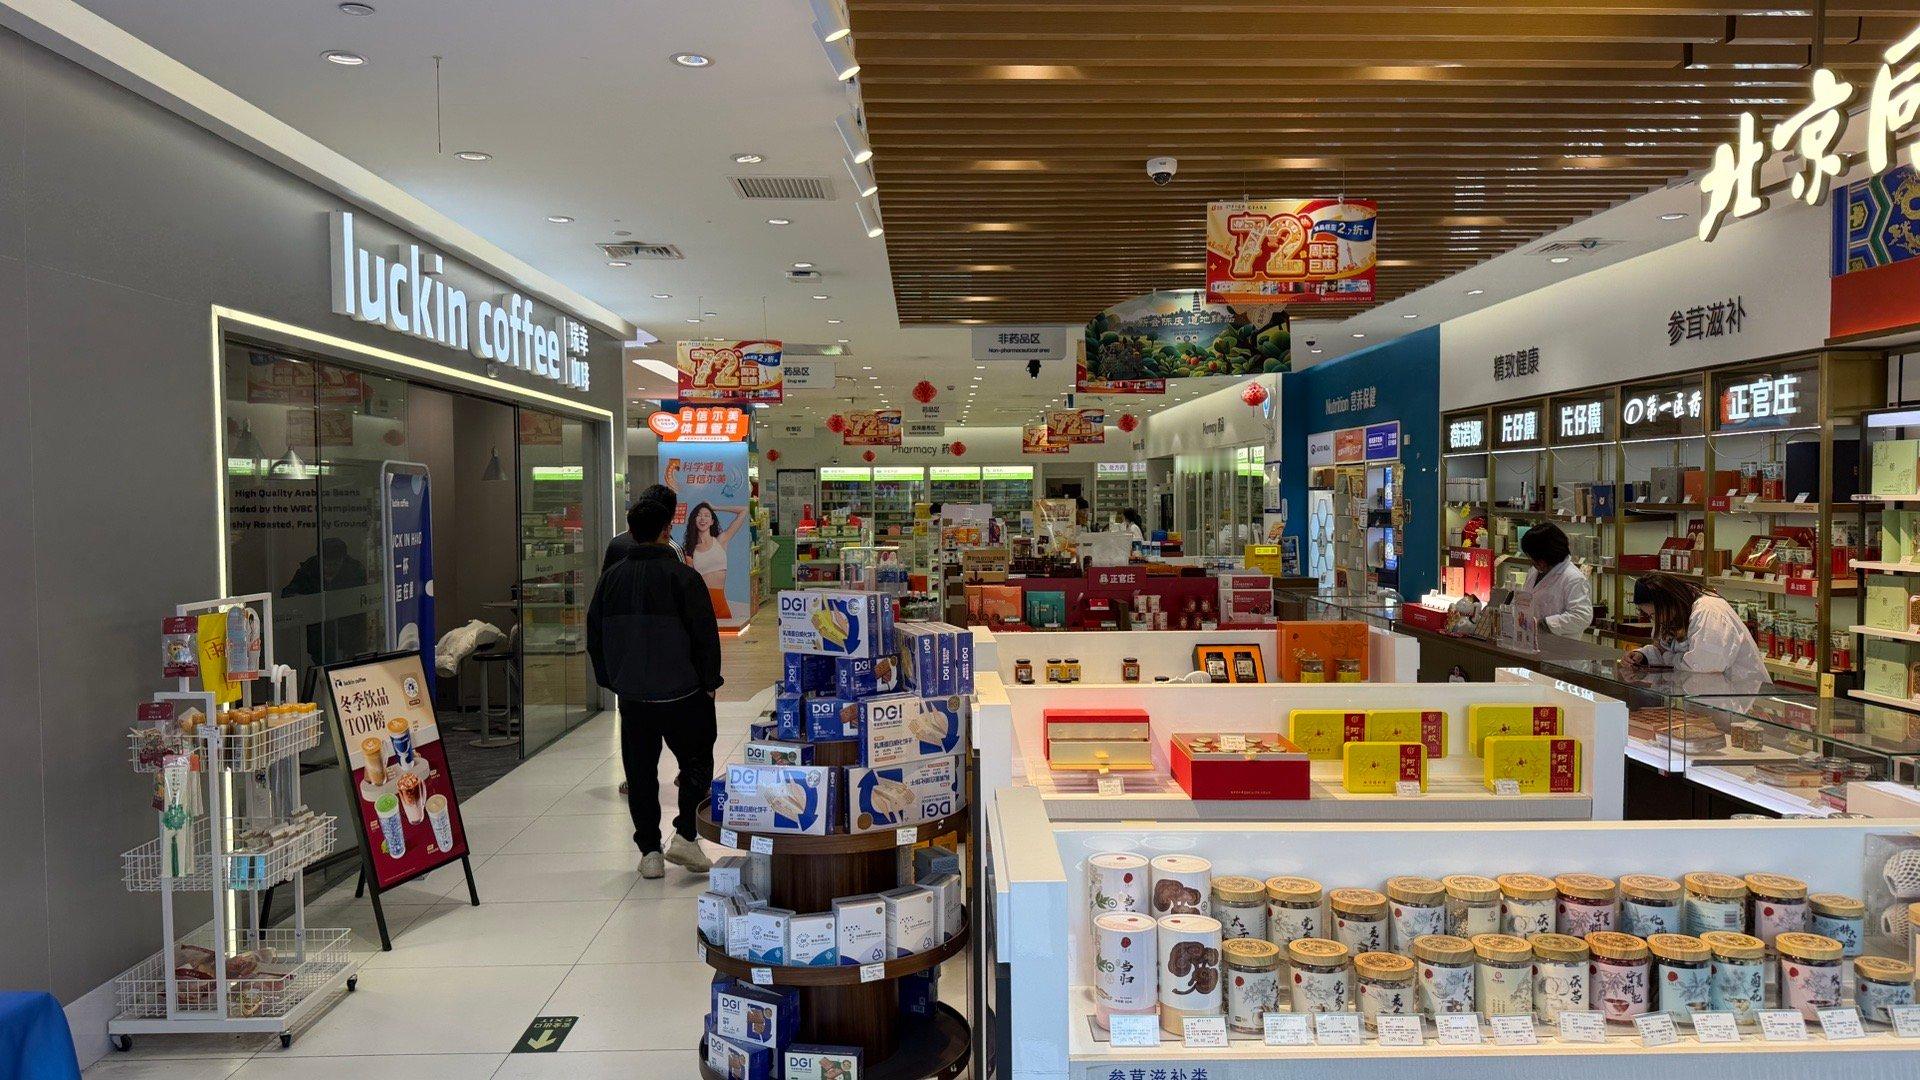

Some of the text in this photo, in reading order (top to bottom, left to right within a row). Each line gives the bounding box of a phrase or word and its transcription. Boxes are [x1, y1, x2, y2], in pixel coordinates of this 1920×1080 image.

[1230, 215, 1306, 275] 72
[335, 211, 561, 381] luckin coffee
[1668, 295, 1746, 347] 参茸滋补
[998, 333, 1040, 345] 非药品区
[690, 348, 740, 388] 72
[784, 366, 810, 377] 药品区
[1493, 346, 1539, 382] 精致健康
[1728, 375, 1797, 420] 正官庄
[682, 410, 741, 421] 自信尔美
[681, 422, 738, 434] 体重管理
[892, 444, 938, 457] Pharmacy
[235, 489, 257, 500] High
[272, 504, 287, 513] the
[1110, 574, 1136, 584] 正官庄
[782, 597, 807, 612] DGI
[854, 659, 871, 671] DGI
[340, 687, 390, 714] 冬季饮品
[812, 703, 835, 713] DGI
[783, 711, 791, 728] DGI
[873, 703, 903, 722] DGI
[346, 710, 386, 737] TOP榜
[747, 747, 765, 758] DGI
[1406, 758, 1417, 776] 阿胶
[1557, 754, 1568, 774] 阿胶
[730, 768, 759, 785] DGI
[922, 801, 951, 819] DGI
[1231, 915, 1250, 938] 太子
[1119, 959, 1135, 986] 当归
[1333, 979, 1345, 1012] 党参
[1569, 974, 1582, 1005] 茯苓
[722, 997, 740, 1011] DGI
[711, 1037, 724, 1053] DGI
[790, 1057, 812, 1068] DGI
